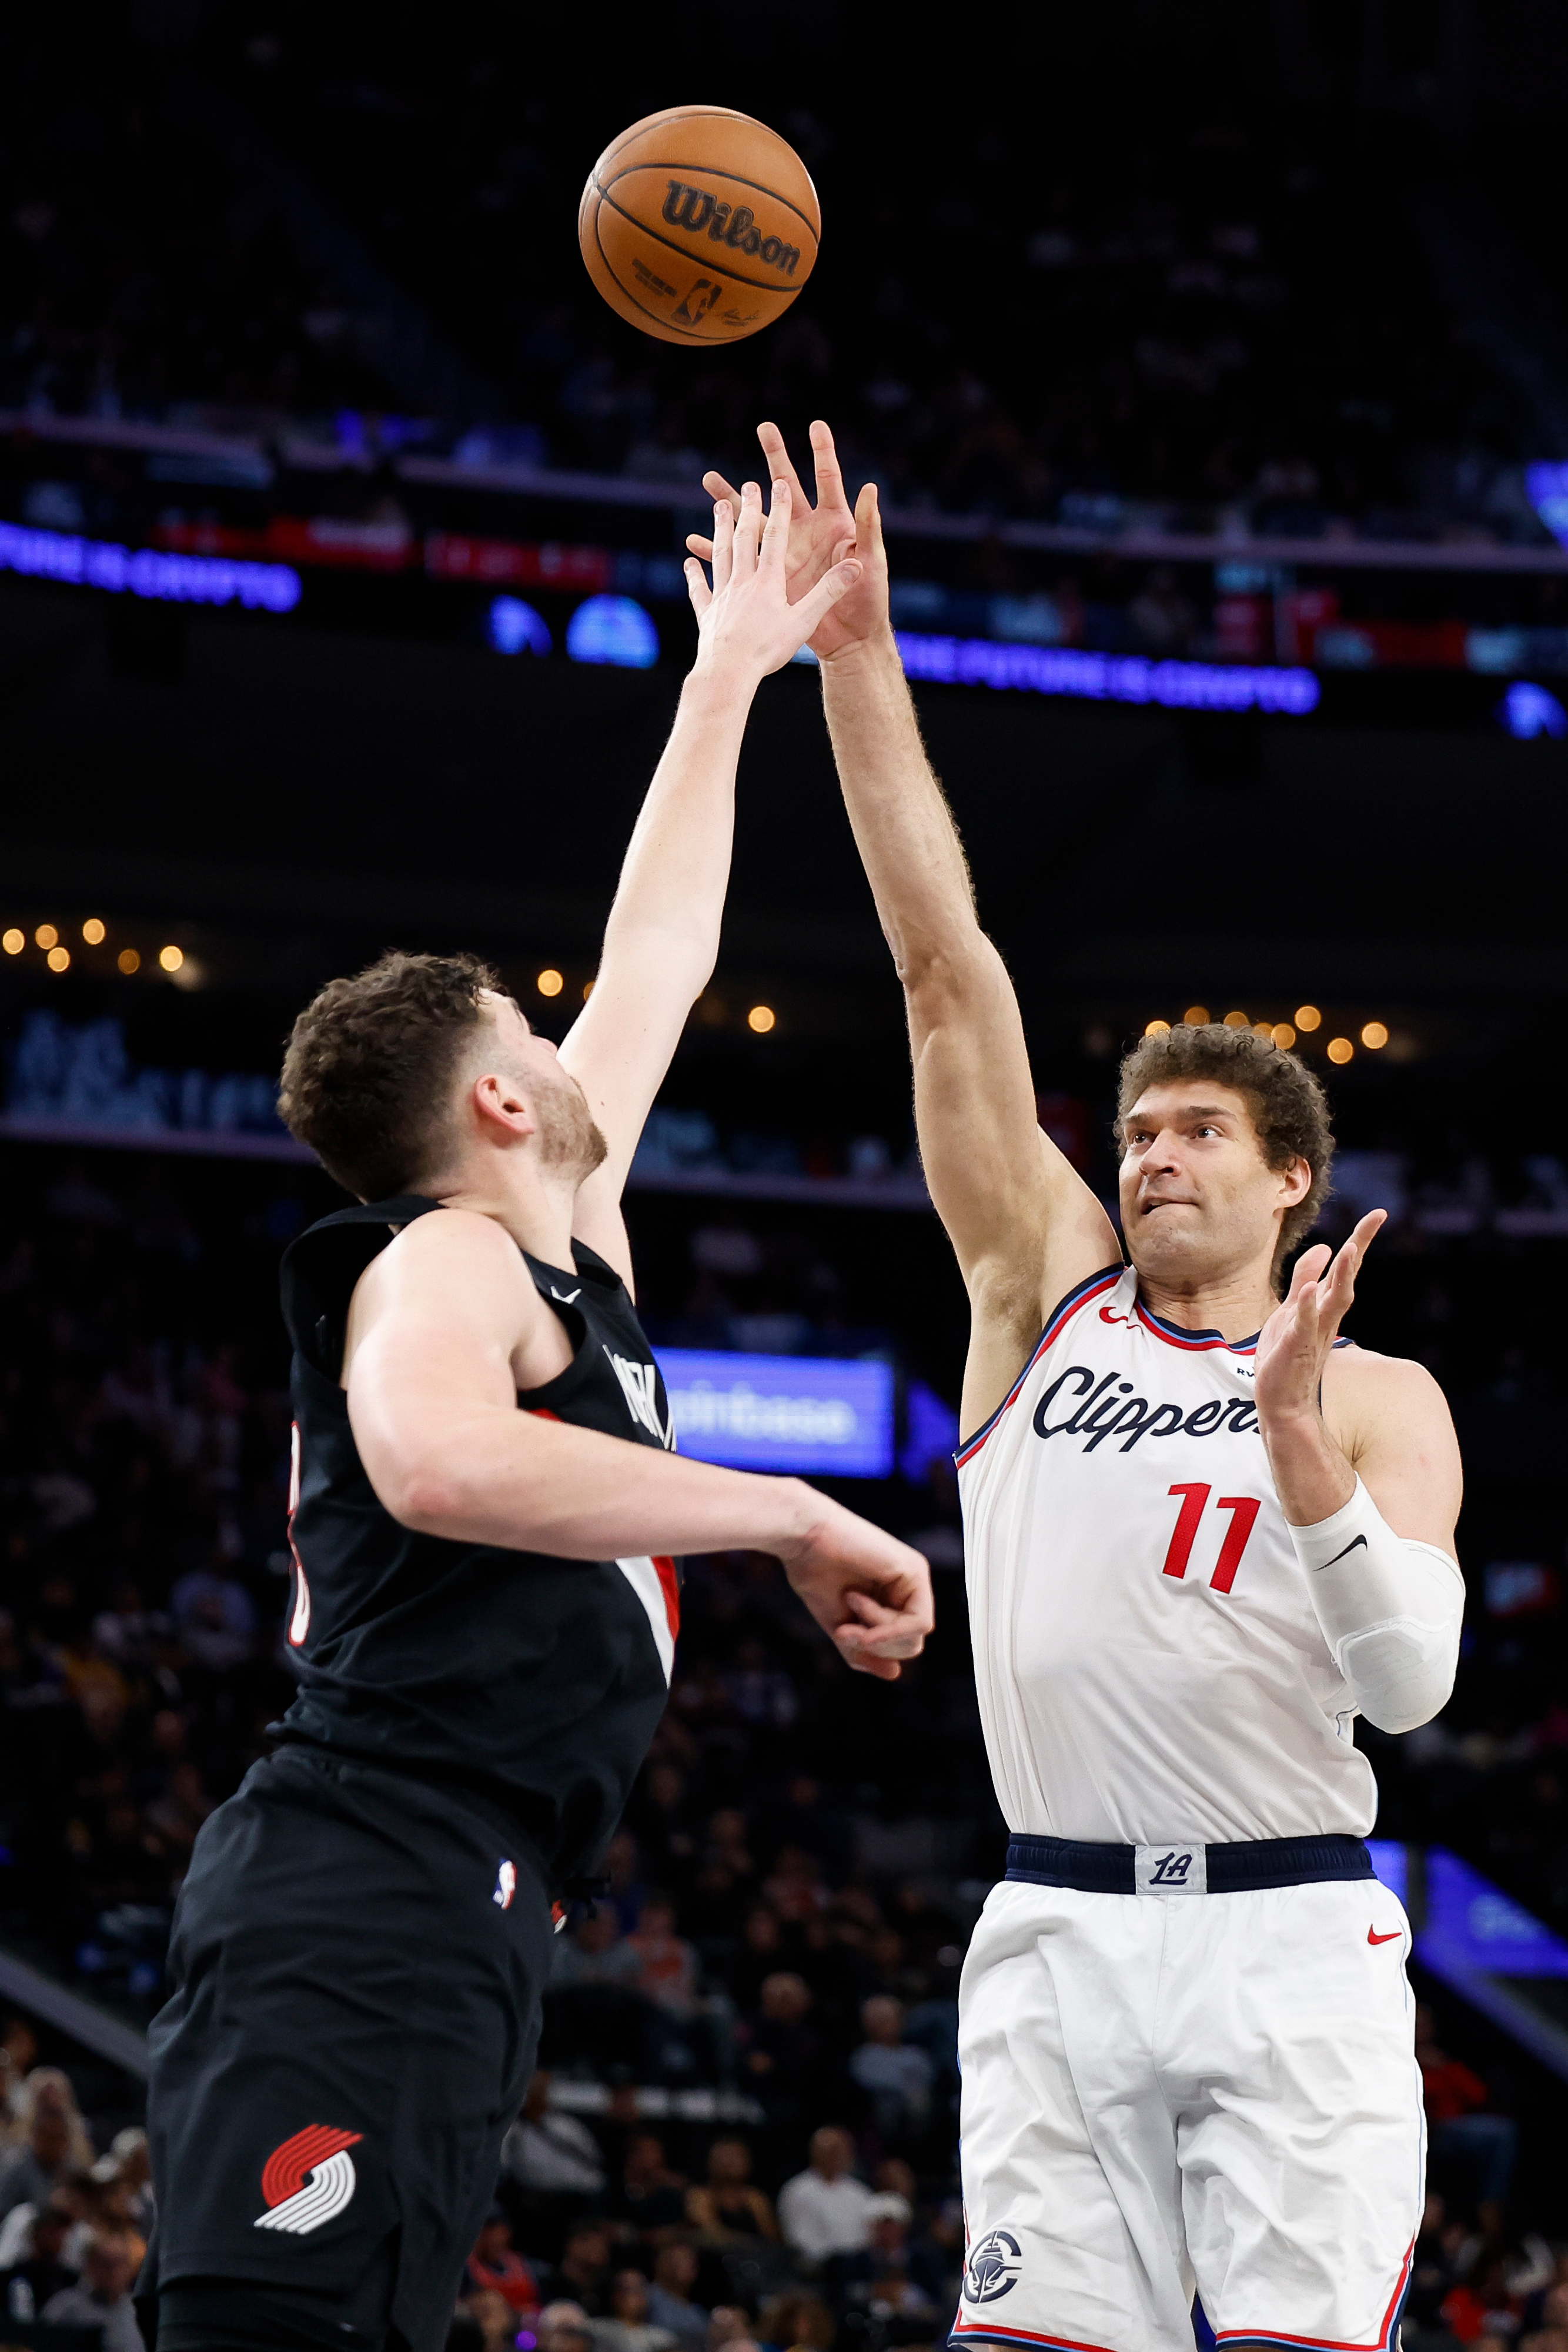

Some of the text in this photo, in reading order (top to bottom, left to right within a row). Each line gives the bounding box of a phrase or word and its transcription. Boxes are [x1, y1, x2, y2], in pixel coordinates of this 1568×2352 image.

[662, 179, 801, 277] Wilson
[1162, 1482, 1262, 1595] 11
[1148, 1851, 1192, 1885] LA
